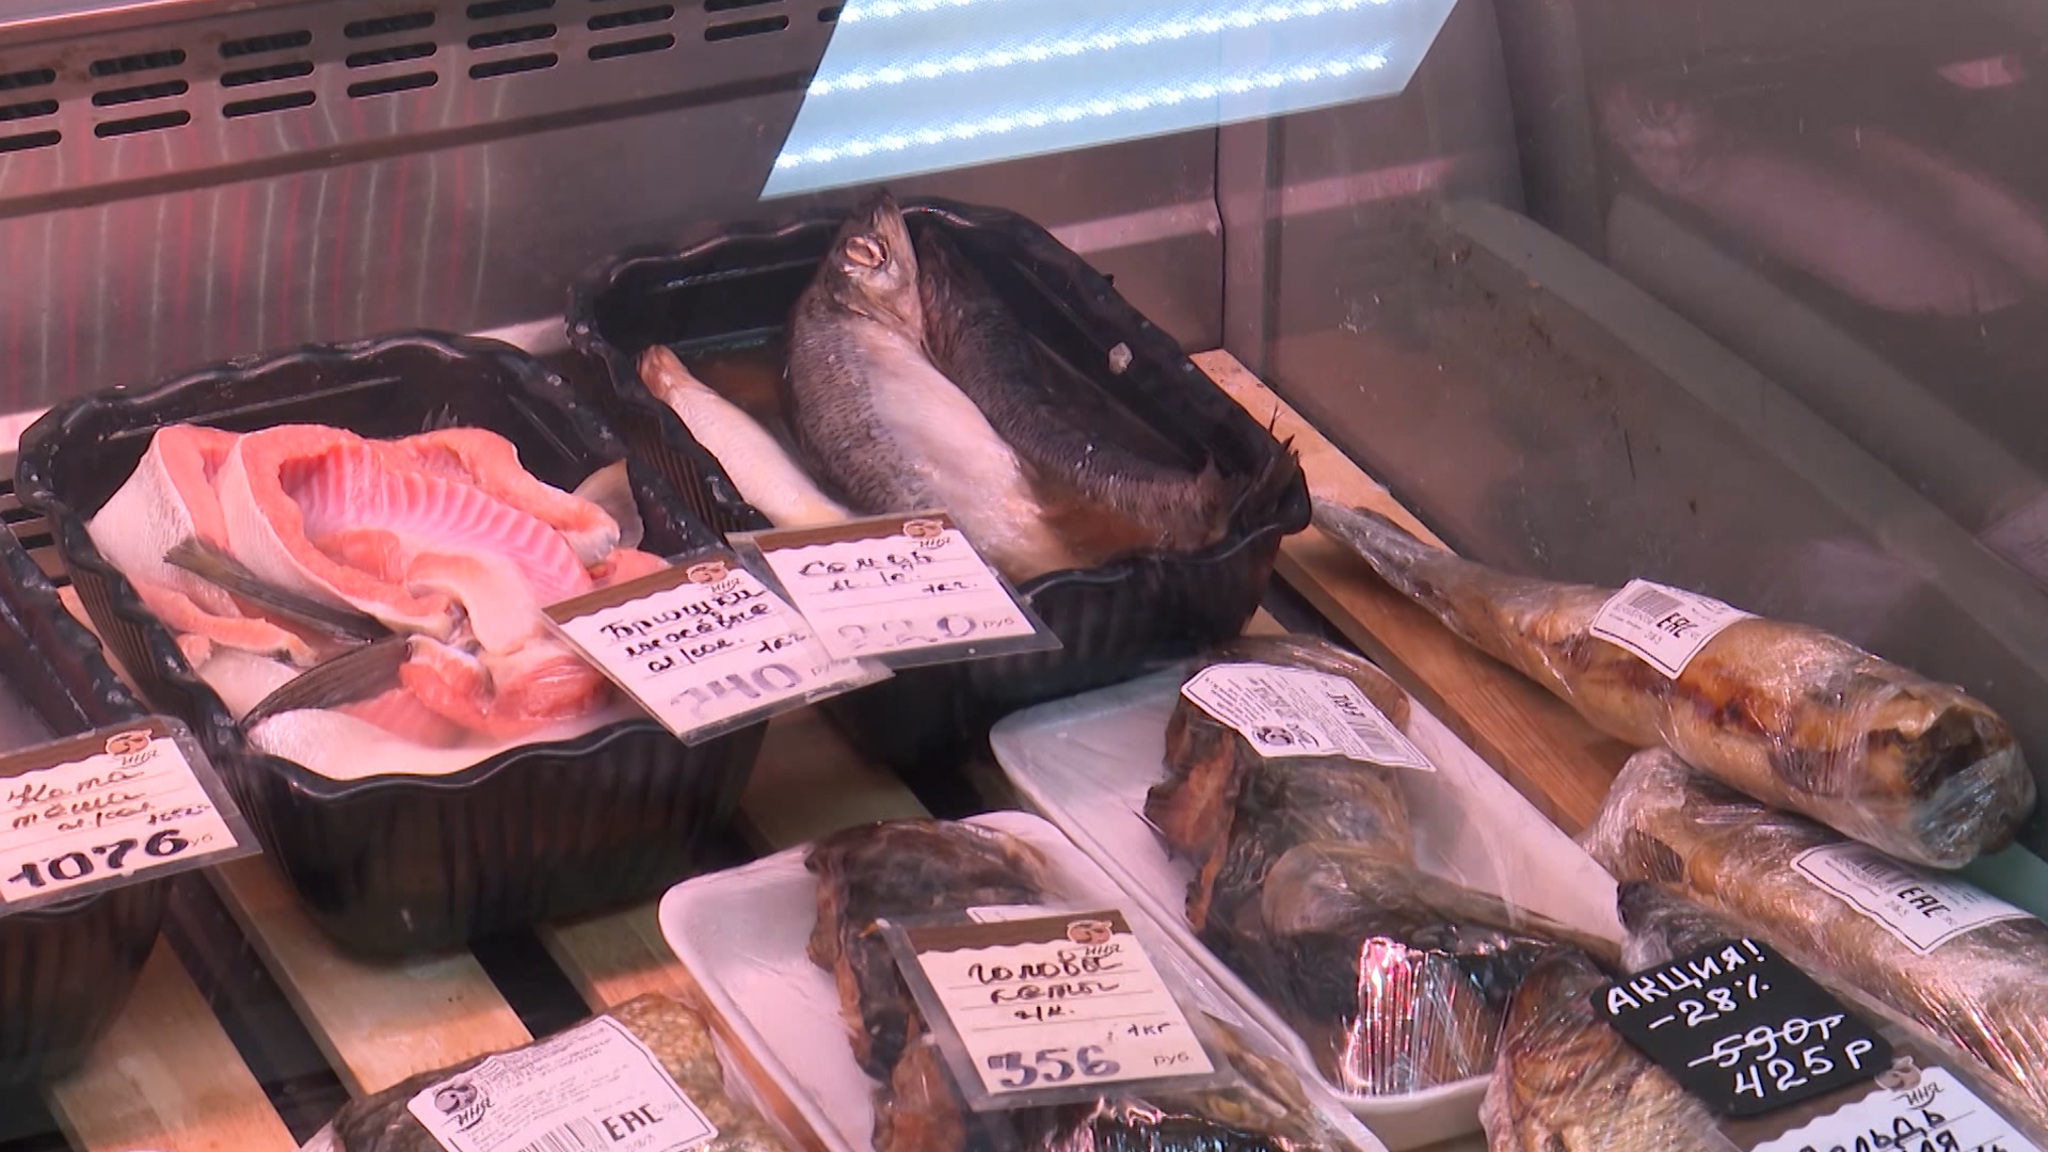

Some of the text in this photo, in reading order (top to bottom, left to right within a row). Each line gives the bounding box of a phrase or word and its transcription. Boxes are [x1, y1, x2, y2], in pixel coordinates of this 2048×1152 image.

[8, 828, 189, 888] 1076
[1607, 938, 1765, 1015] АКЦИЯ!
[986, 1045, 1121, 1089] 356
[1734, 1045, 1835, 1098] 425
